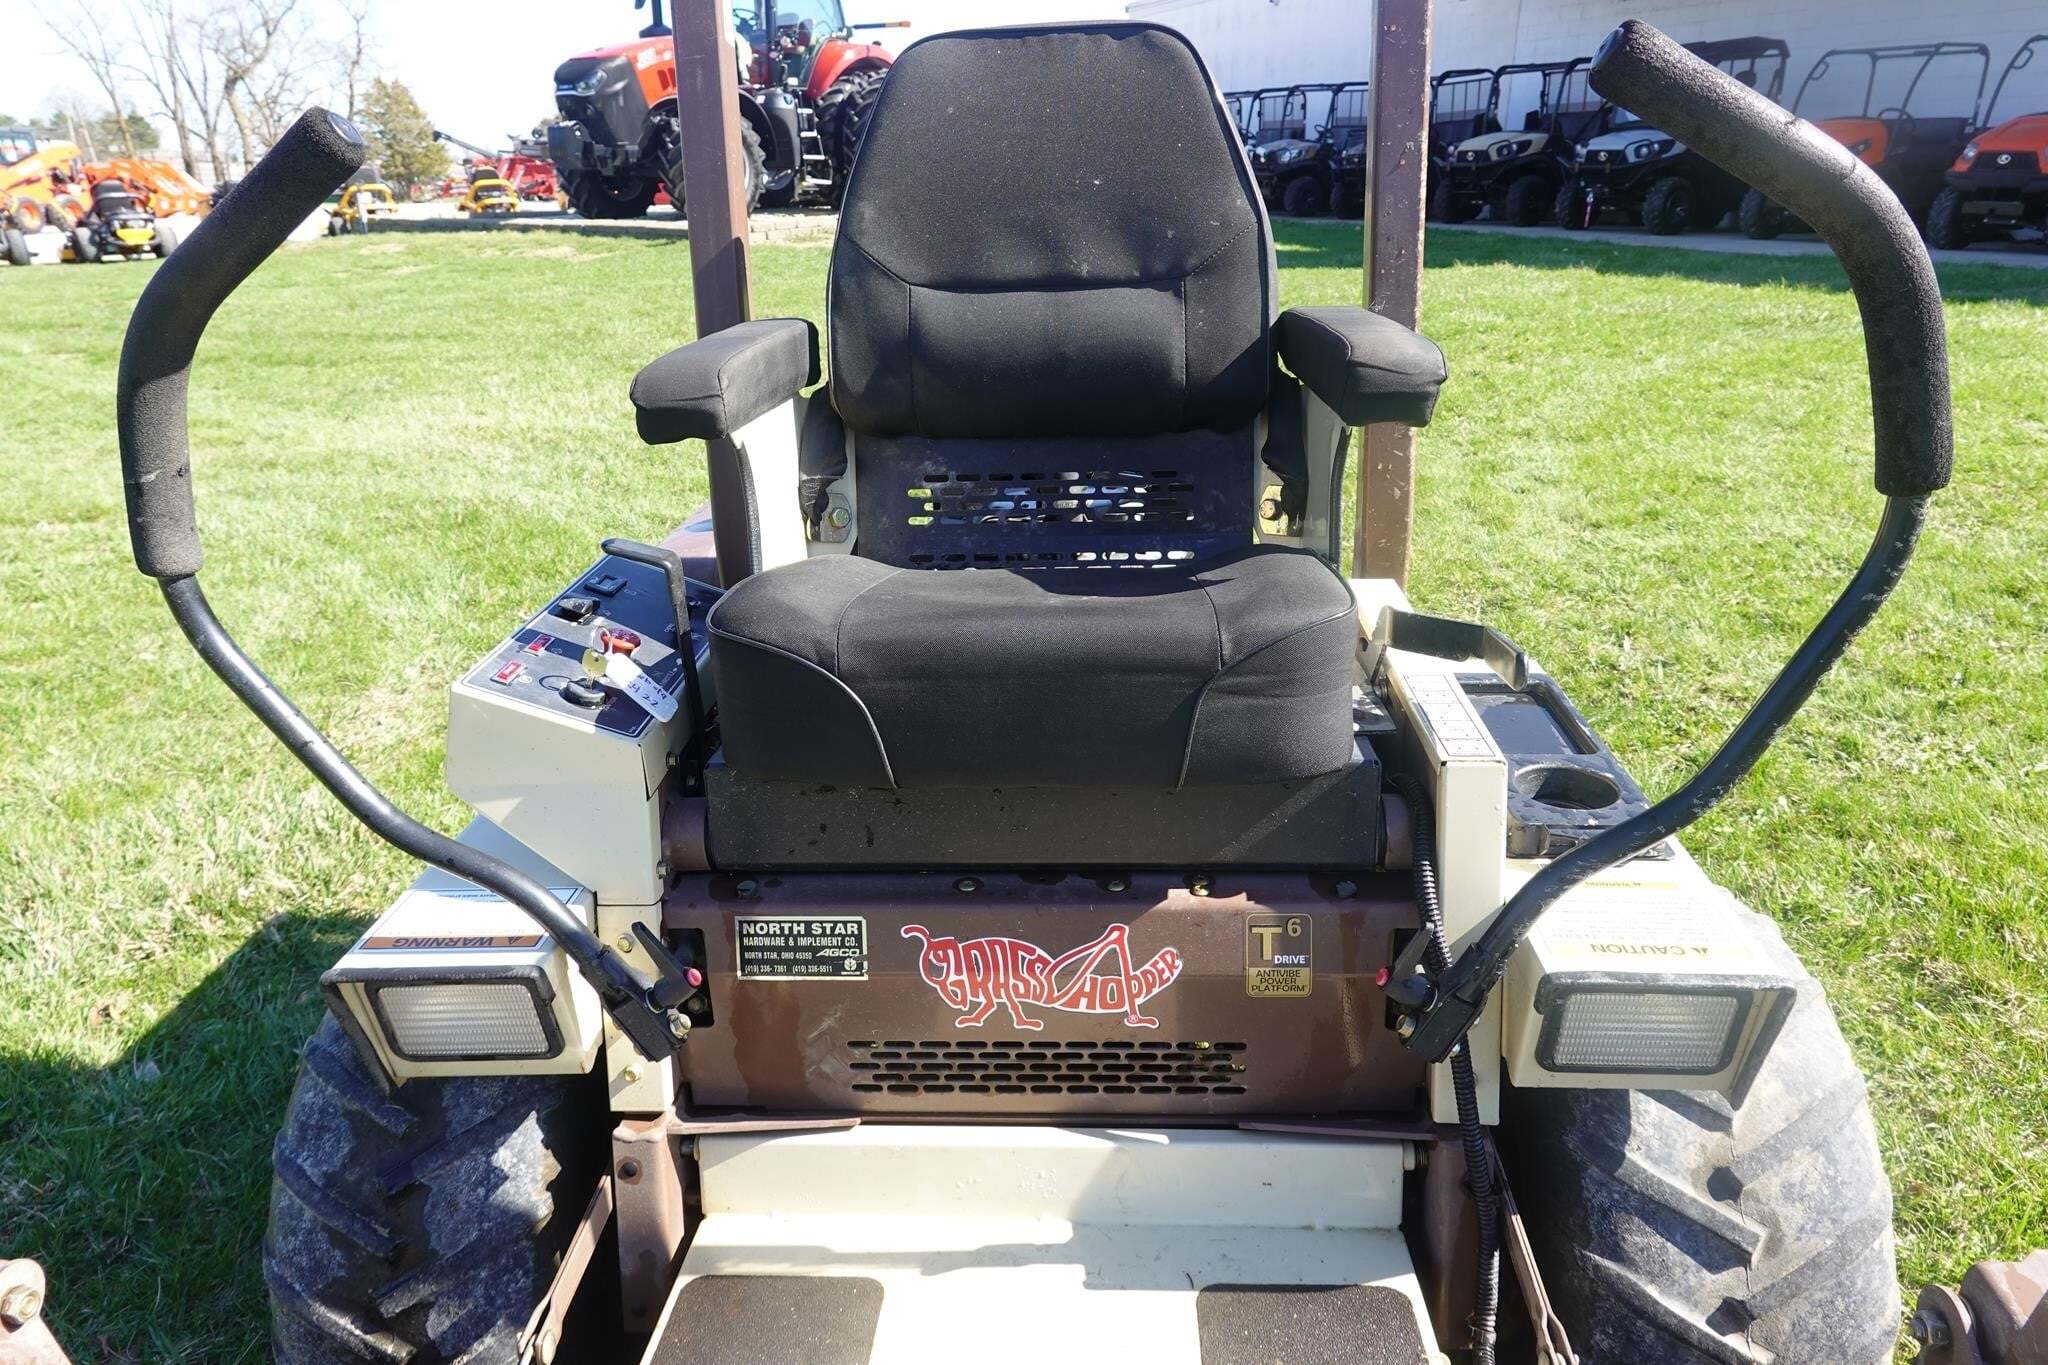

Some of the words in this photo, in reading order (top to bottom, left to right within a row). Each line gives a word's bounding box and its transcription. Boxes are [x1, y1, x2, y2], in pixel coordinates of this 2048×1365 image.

[742, 922, 805, 935] NORTH
[811, 922, 859, 935] STAR
[391, 936, 494, 948] WARNING
[743, 936, 785, 947] HARDWARE
[788, 936, 795, 946] &
[797, 936, 841, 947] IMPLEMENT
[845, 936, 859, 947] CO.
[816, 948, 860, 957] AGCO
[1589, 943, 1685, 956] CAUTION
[744, 951, 762, 960] NORTH
[1274, 954, 1306, 965] DRIVE
[792, 964, 806, 974] (419)
[1256, 969, 1302, 978] ANTIVIBE
[900, 923, 1184, 1031] GRASSHOPPER
[1260, 977, 1297, 985] POWER
[1251, 984, 1306, 992] PLATFORM
